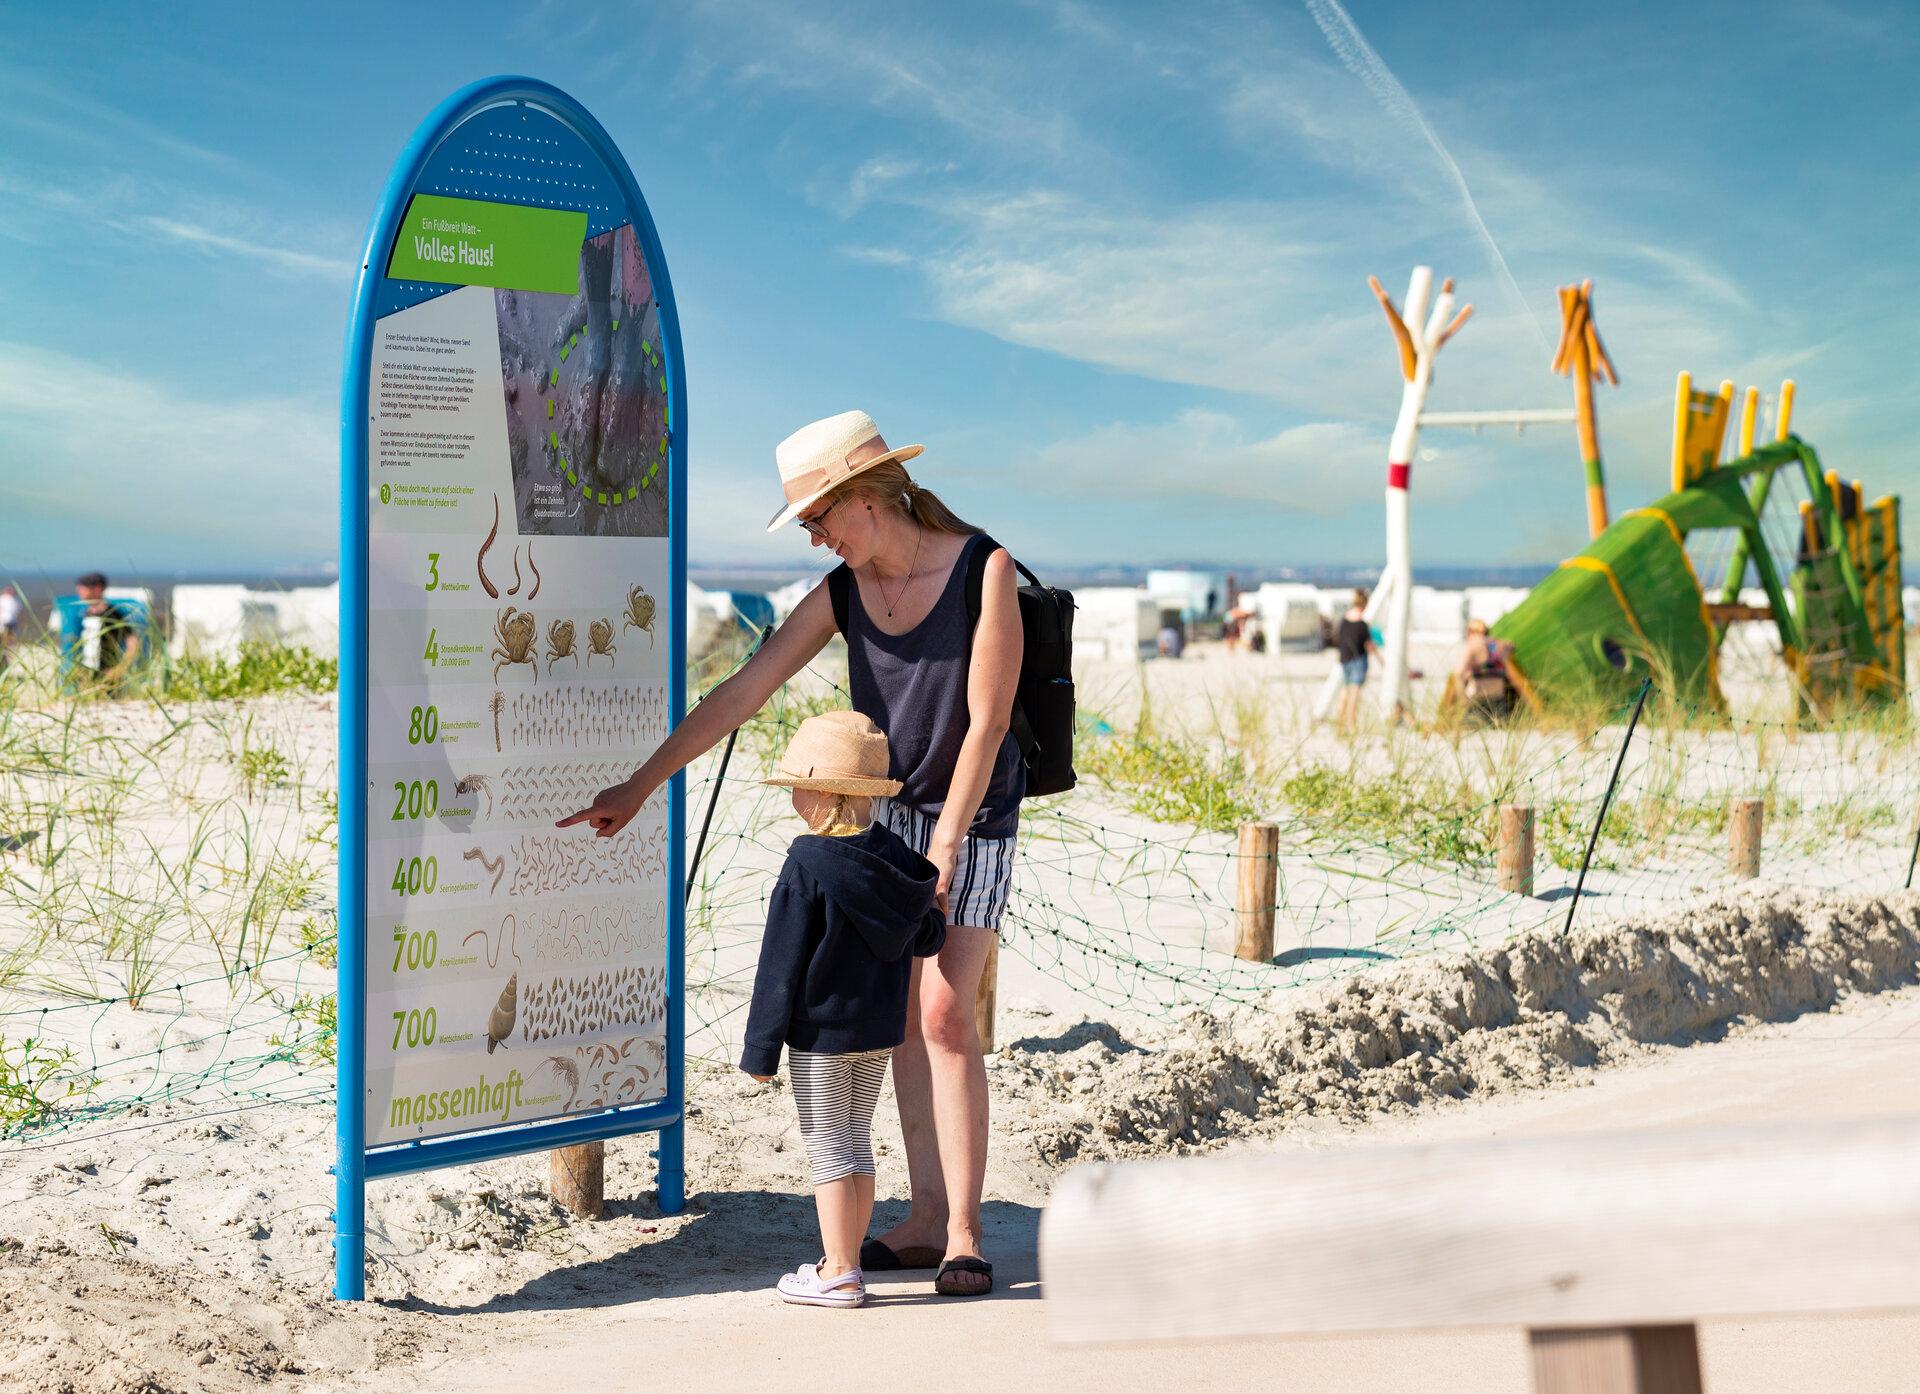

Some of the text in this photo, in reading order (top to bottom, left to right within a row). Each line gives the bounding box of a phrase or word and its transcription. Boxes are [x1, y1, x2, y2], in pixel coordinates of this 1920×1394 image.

[422, 218, 432, 230] Ein
[434, 218, 460, 234] Fußbreit
[462, 222, 476, 235] Watt
[415, 236, 494, 266] Volles Haus!
[394, 484, 408, 492] Schau
[409, 484, 420, 493] doch
[441, 486, 450, 495] auf
[450, 486, 462, 494] solch
[394, 497, 409, 506] Fläche
[410, 498, 416, 506] im
[434, 499, 449, 508] finden
[425, 553, 470, 591] 3 Wattwürmer
[424, 627, 438, 666] 4
[474, 644, 483, 653] mit
[409, 705, 438, 745] 80
[391, 780, 438, 820] 200
[392, 856, 437, 896] 400
[393, 930, 437, 972] 700
[392, 1007, 436, 1050] 700
[390, 1069, 523, 1128] massenhaft
